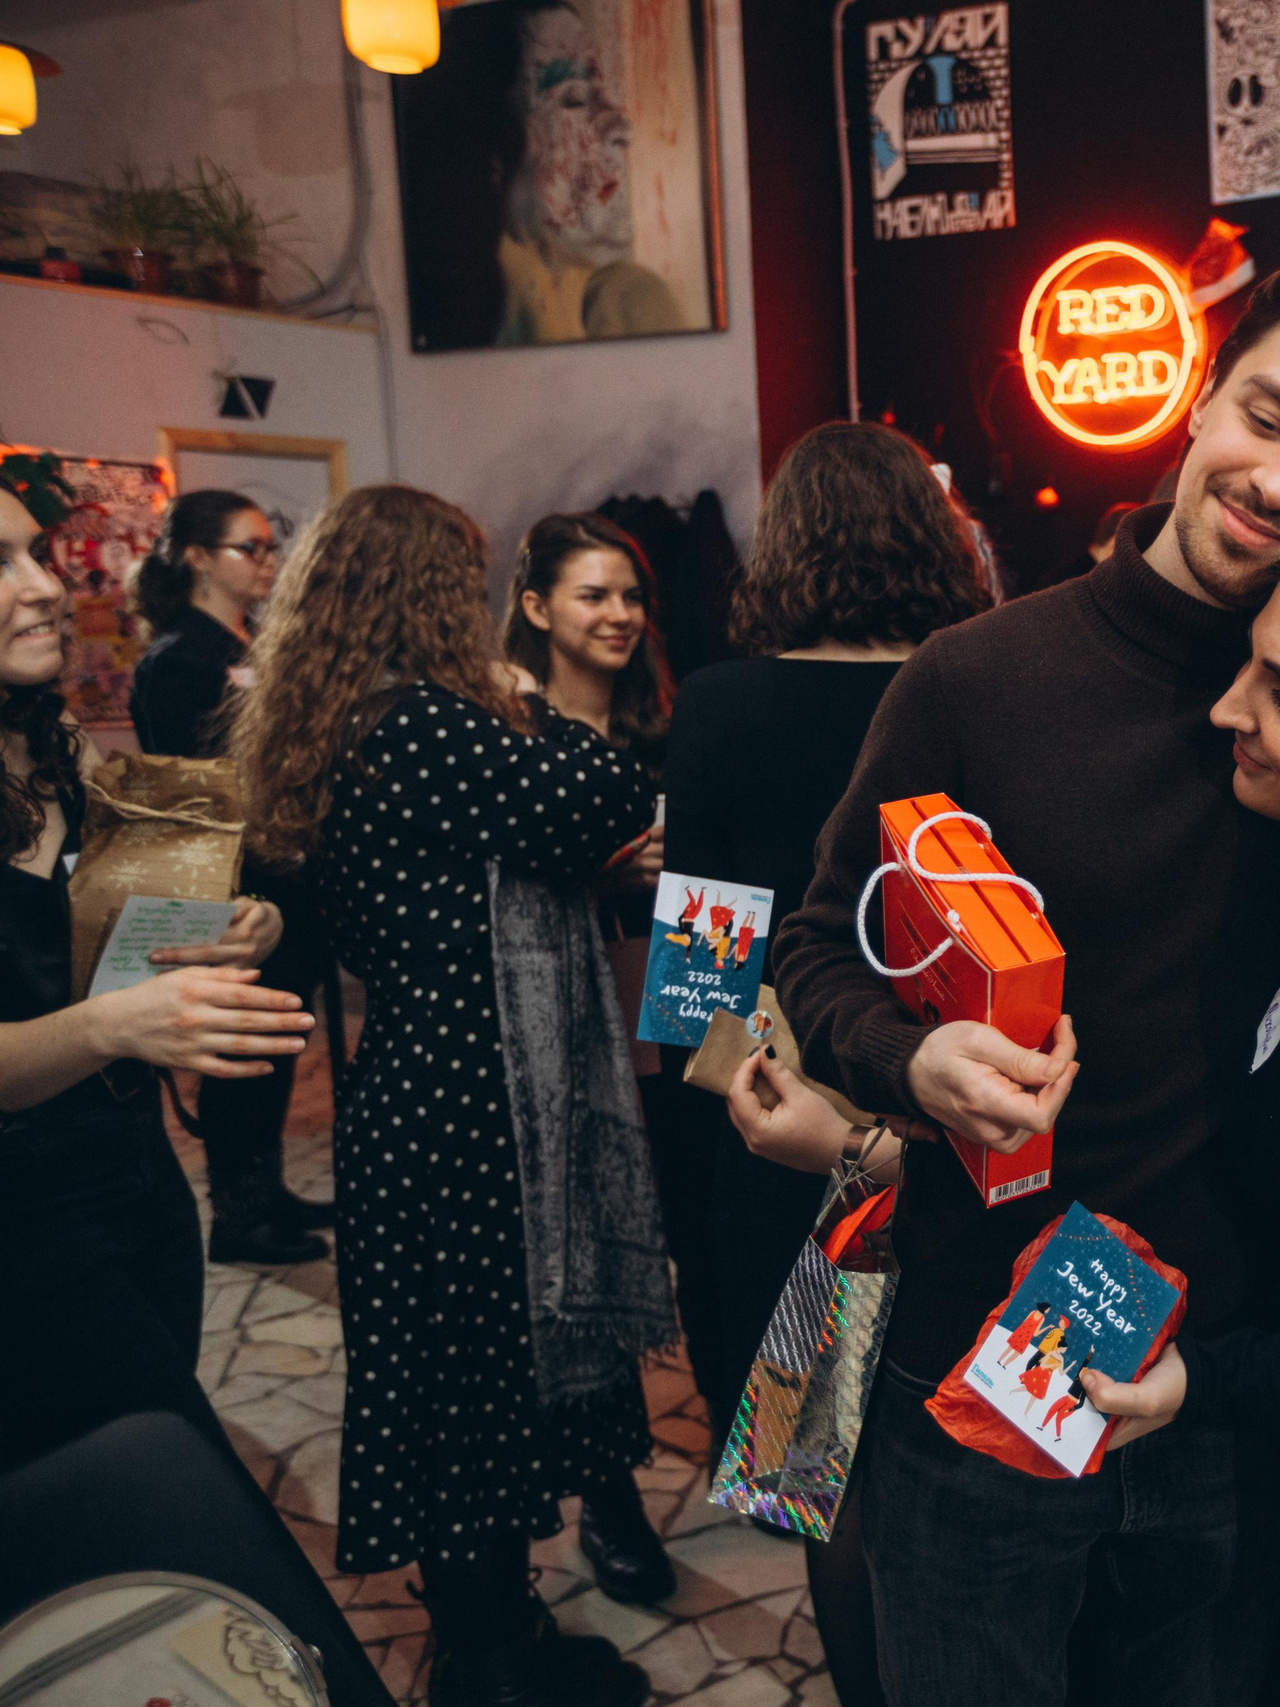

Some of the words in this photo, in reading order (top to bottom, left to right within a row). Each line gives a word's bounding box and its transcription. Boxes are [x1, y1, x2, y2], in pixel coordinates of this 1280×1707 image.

[1056, 284, 1165, 335] RED
[1038, 350, 1178, 404] YARD
[660, 984, 702, 1004] Year
[687, 970, 722, 986] 2022
[706, 990, 742, 1009] Jew
[1056, 1260, 1094, 1298] Jew
[1095, 1292, 1137, 1334] Year
[1090, 1258, 1127, 1303] Happy
[1069, 1300, 1102, 1336] 2022
